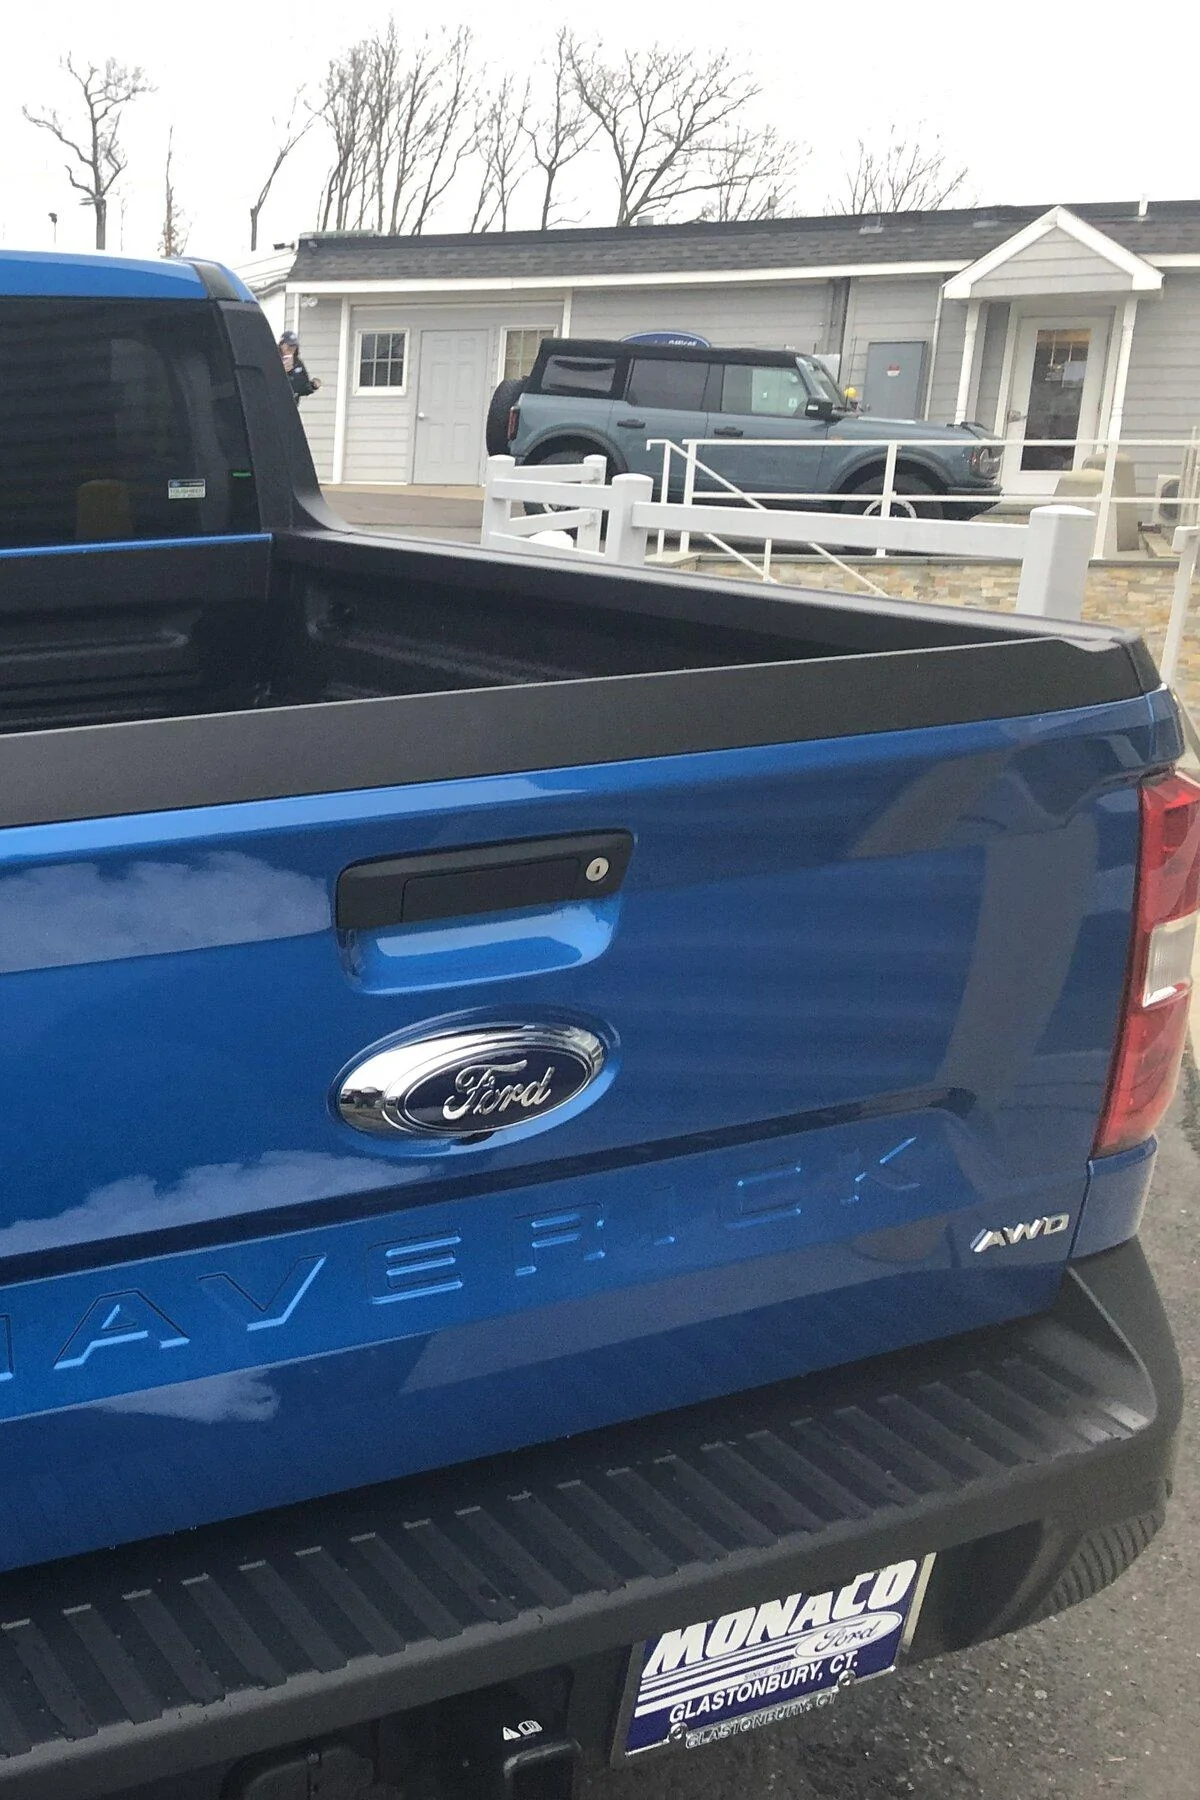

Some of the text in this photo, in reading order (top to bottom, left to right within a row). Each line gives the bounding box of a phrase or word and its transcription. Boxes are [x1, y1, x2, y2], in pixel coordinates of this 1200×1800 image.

[442, 1058, 556, 1121] Ford
[970, 1212, 1070, 1253] AWD
[642, 1559, 918, 1677] MONACO
[814, 1618, 879, 1653] Ford
[669, 1650, 859, 1724] GLASTONBURY, CT.
